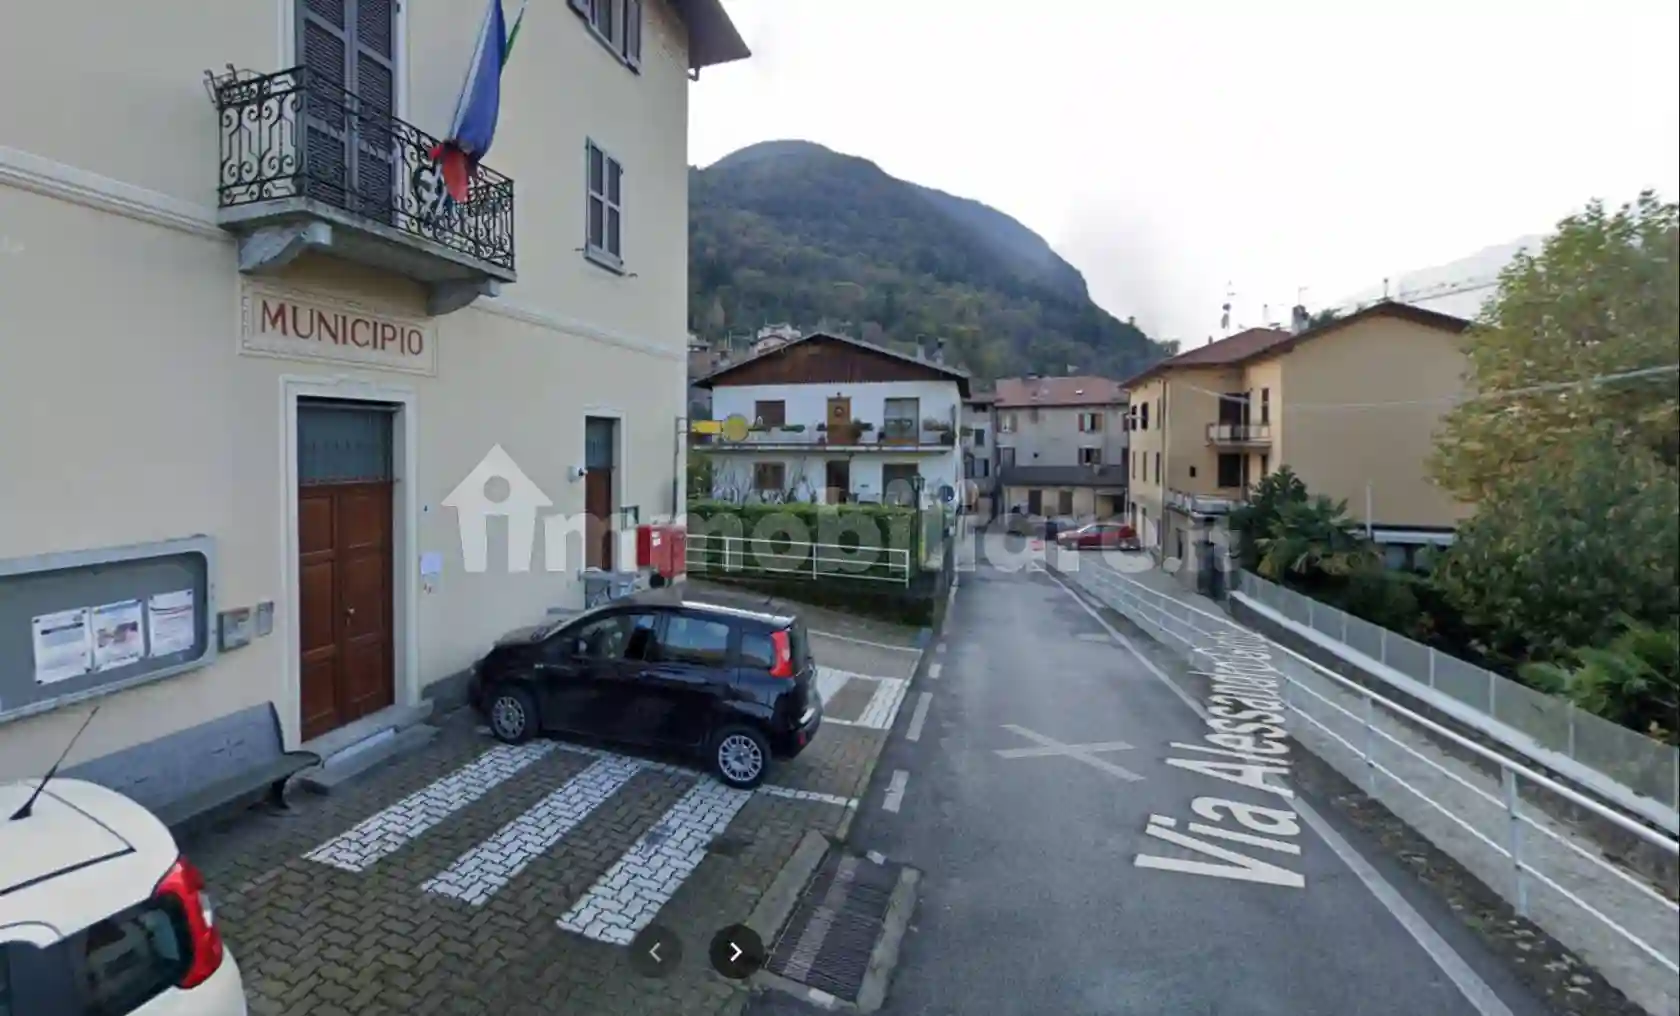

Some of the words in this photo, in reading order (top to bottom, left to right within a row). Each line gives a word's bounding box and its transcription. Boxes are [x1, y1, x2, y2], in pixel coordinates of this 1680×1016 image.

[261, 300, 423, 355] MUNICIPIO
[1165, 661, 1295, 799] Alessandro
[1134, 797, 1305, 888] Via
